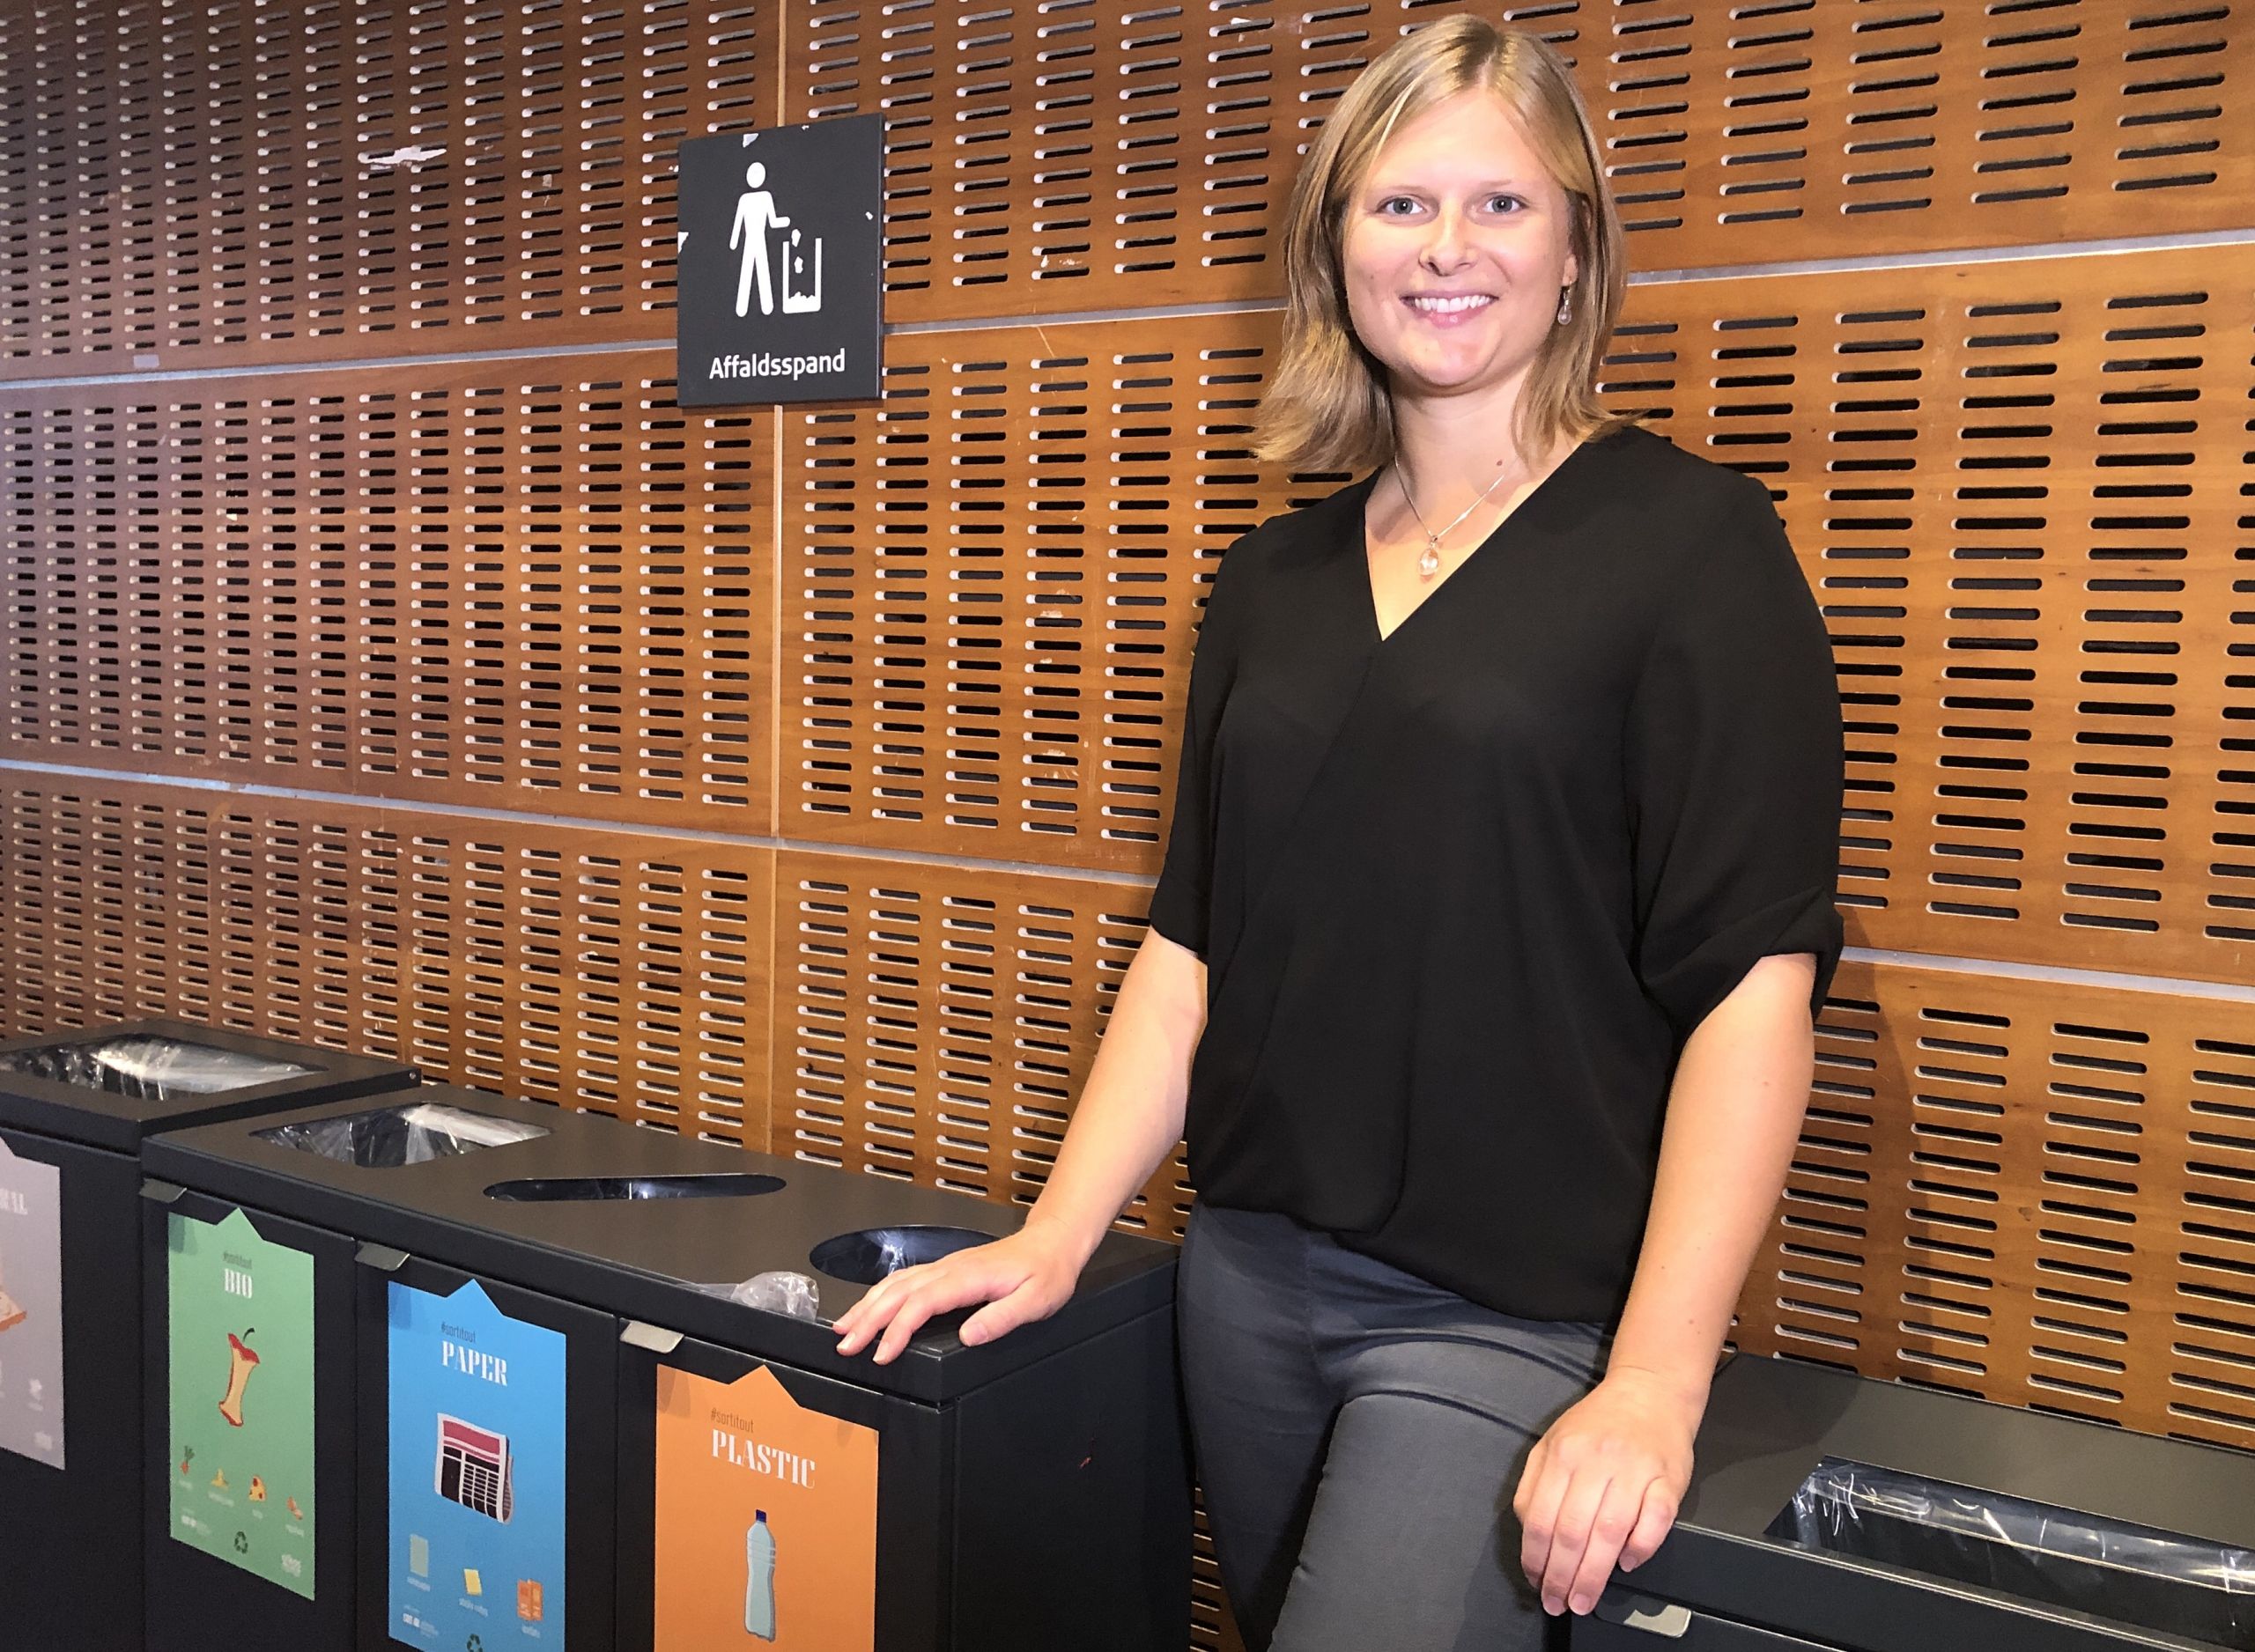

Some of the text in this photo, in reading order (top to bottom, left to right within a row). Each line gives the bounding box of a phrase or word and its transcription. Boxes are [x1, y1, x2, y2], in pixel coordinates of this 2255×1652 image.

[709, 348, 846, 381] Affaldsspand
[225, 1268, 253, 1299] BIO
[442, 1340, 508, 1387] PAPER
[711, 1407, 755, 1434] #sortitout
[712, 1428, 816, 1489] PLASTIC
